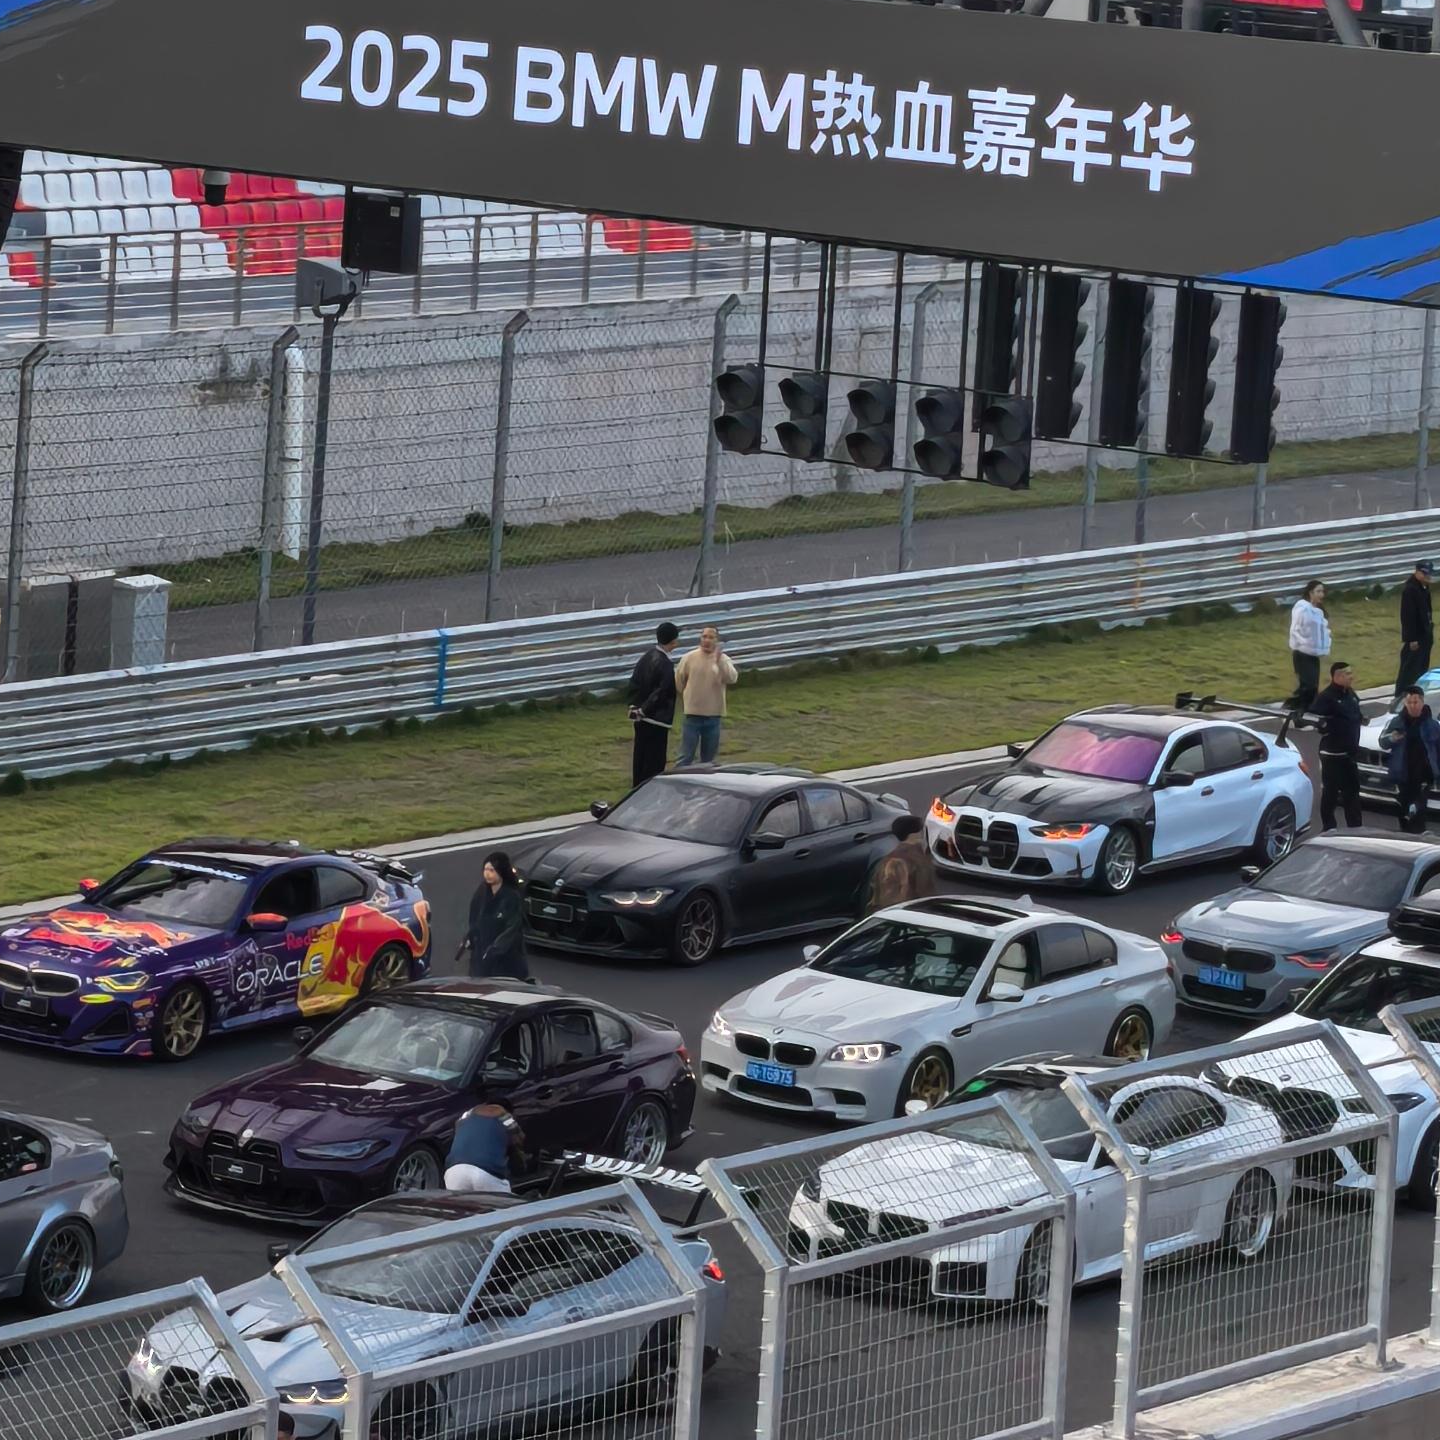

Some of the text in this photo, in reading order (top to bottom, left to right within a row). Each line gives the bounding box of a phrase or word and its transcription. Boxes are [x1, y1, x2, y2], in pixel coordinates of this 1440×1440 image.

[299, 24, 490, 118] 2025
[512, 45, 719, 141] BMW
[236, 953, 324, 992] ORACLE
